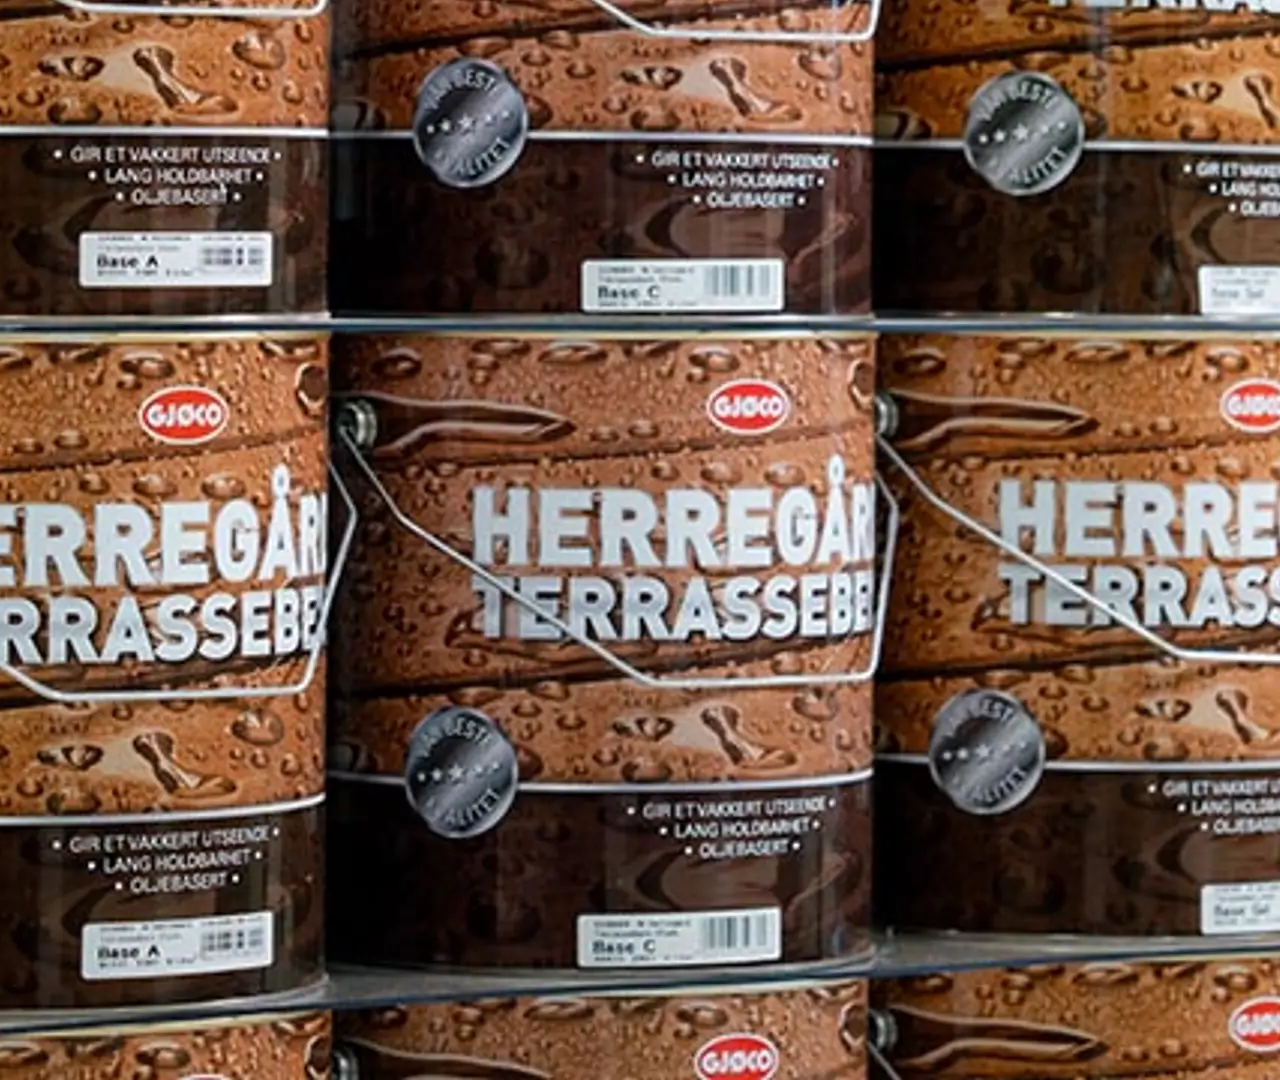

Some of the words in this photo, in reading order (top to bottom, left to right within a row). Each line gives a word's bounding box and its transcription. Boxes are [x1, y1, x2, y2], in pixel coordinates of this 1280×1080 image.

[105, 167, 153, 185] LANG
[647, 284, 662, 300] C
[147, 403, 221, 428] GJØCO
[674, 821, 720, 839] LANG
[102, 855, 153, 874] LANG
[147, 944, 161, 958] A
[642, 938, 657, 954] C
